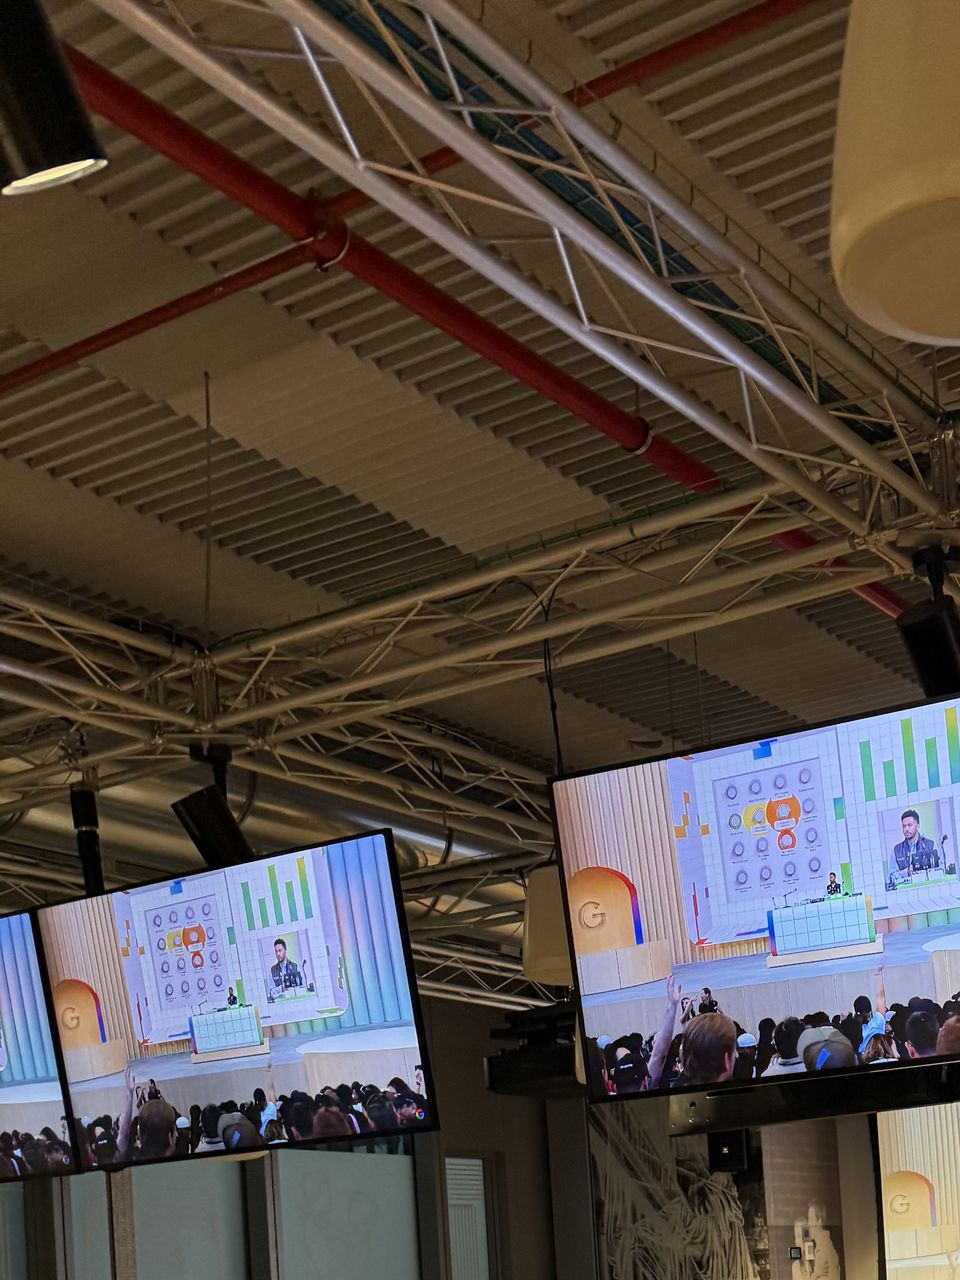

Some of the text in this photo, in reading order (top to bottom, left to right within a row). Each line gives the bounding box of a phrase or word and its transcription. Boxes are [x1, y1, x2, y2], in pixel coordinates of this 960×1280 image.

[577, 901, 606, 929] G
[61, 1006, 80, 1030] G
[889, 1194, 910, 1214] G
